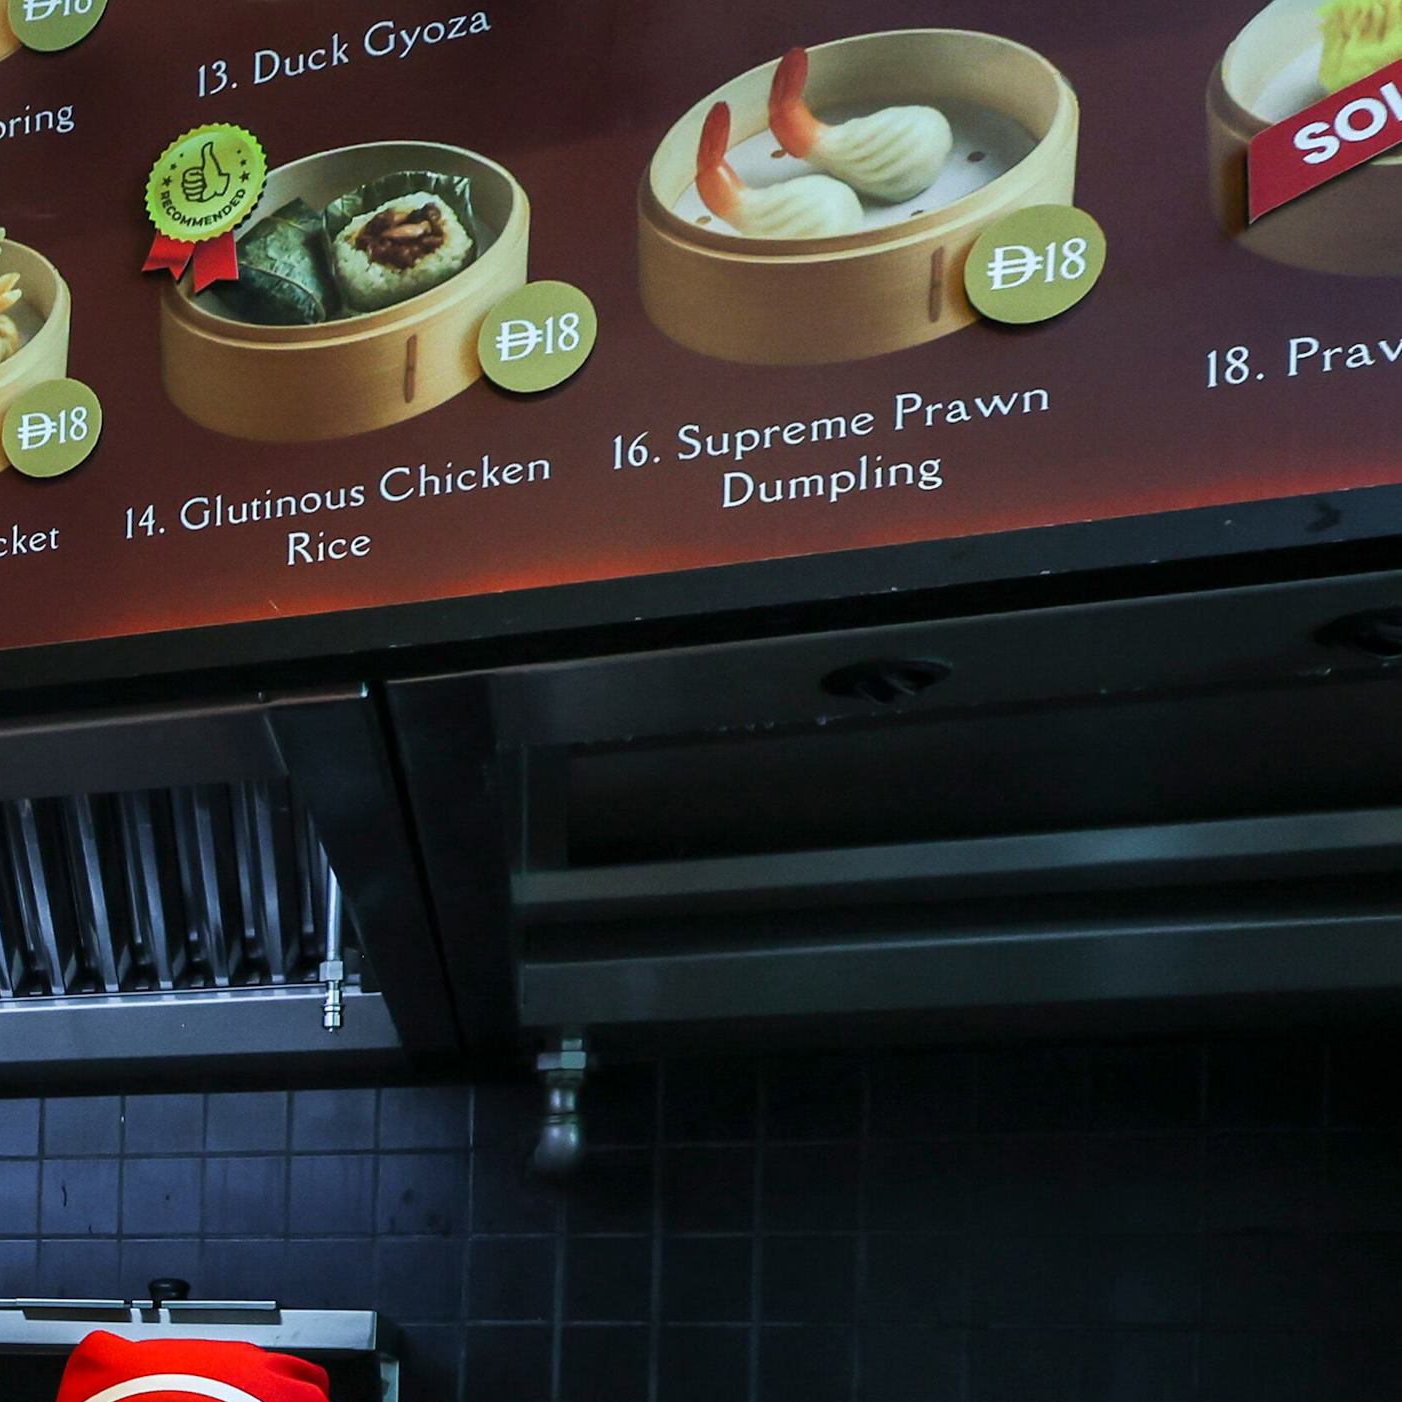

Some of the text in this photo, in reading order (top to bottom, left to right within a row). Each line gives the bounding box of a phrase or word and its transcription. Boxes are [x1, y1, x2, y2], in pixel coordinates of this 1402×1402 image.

[197, 11, 491, 98] 13. Duck Gyoza
[160, 189, 246, 227] RECOMMENDED
[1206, 345, 1265, 388] 18.
[612, 386, 1050, 470] 16. Supreme Prawn
[124, 454, 552, 540] 14. Glutinous Chicken
[722, 454, 943, 508] Dumpling
[286, 530, 372, 566] Rice
